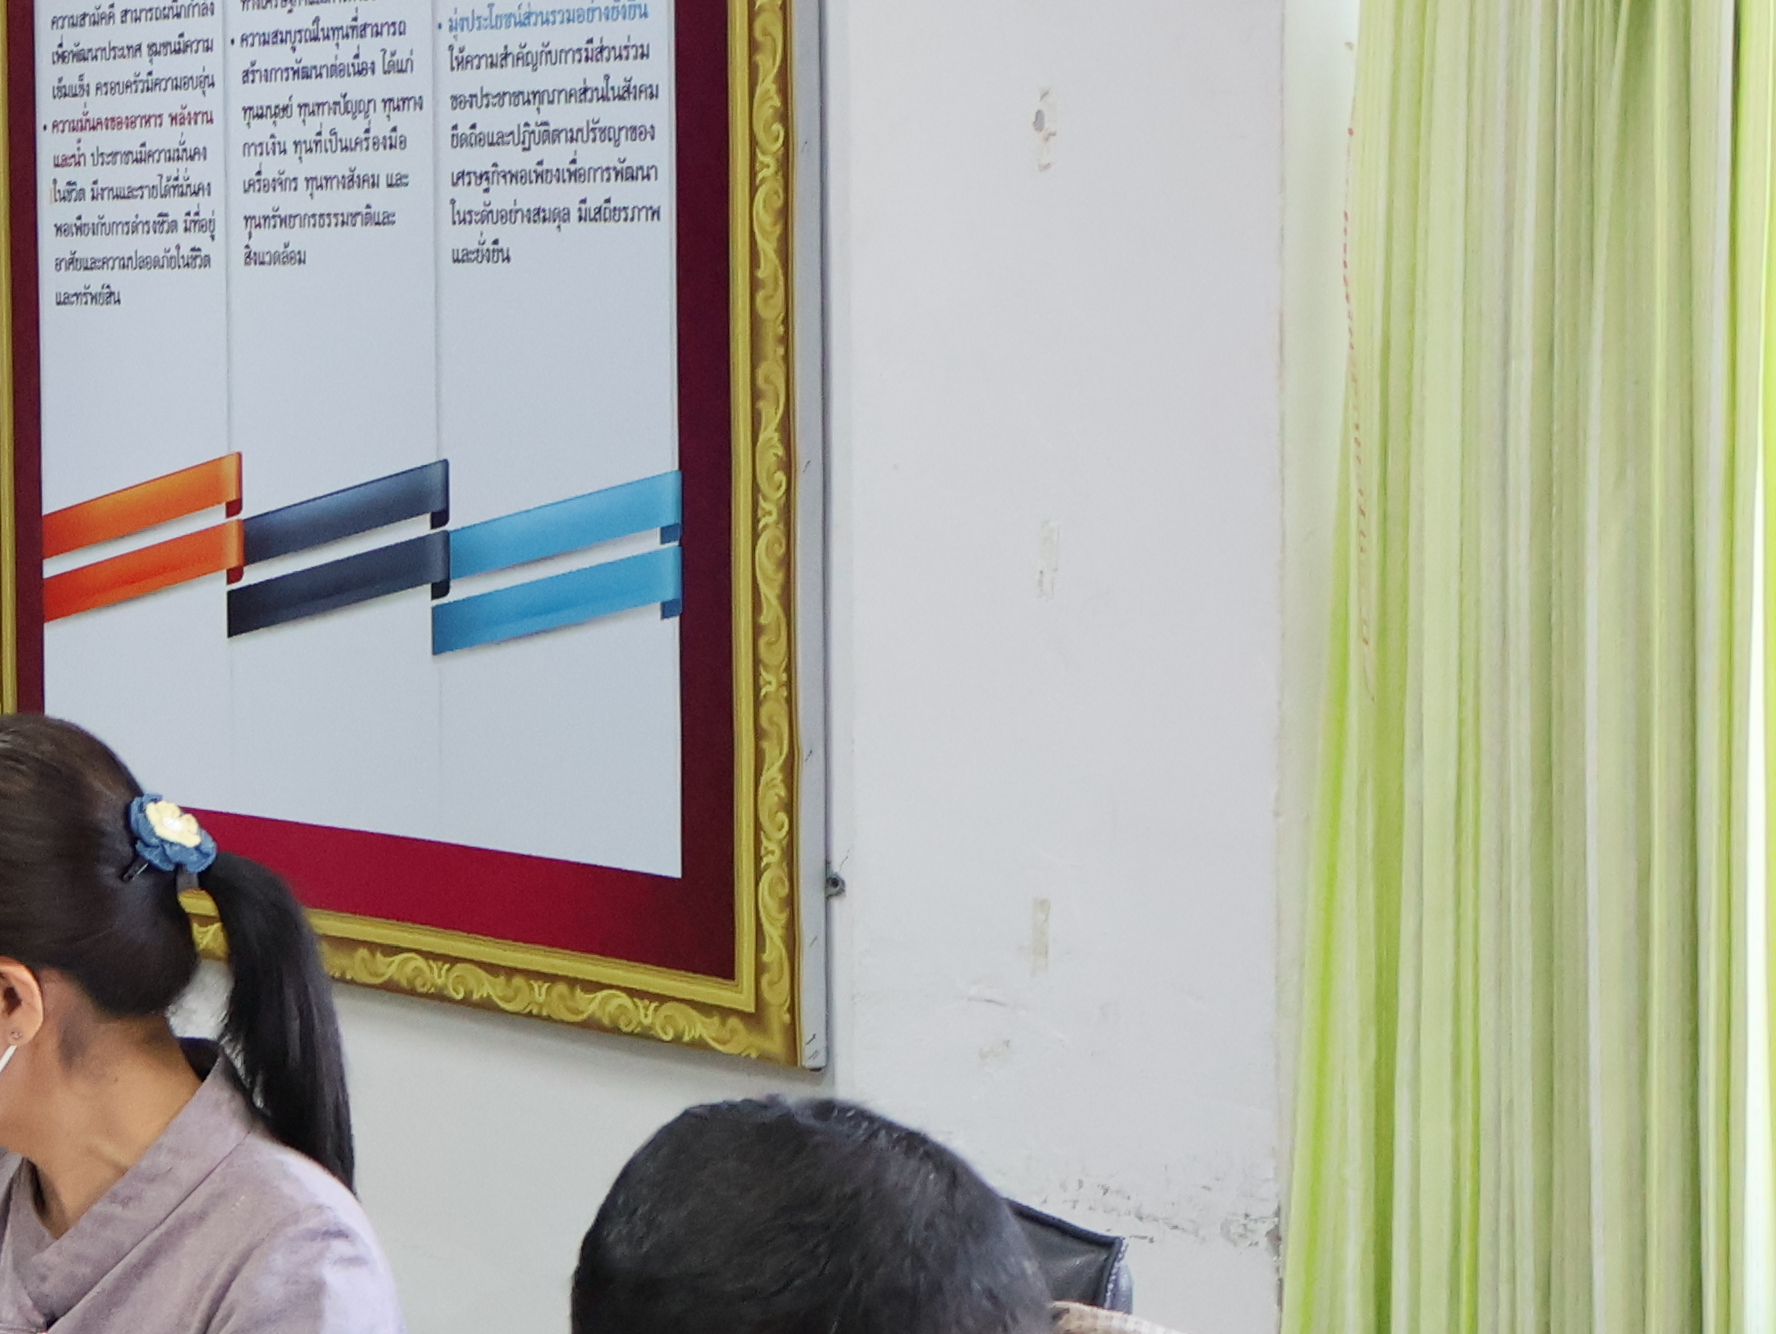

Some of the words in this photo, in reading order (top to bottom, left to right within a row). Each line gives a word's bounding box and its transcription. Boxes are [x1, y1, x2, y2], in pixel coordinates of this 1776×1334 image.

[380, 47, 414, 76] ได้แก่
[380, 94, 424, 122] ทุนทาง
[242, 132, 288, 157] การเงิน
[304, 166, 380, 200] ทุนทางสังคม
[385, 172, 410, 189] และ
[577, 196, 661, 224] มีเสถียรภาพ
[451, 231, 512, 265] และยั่งยืน
